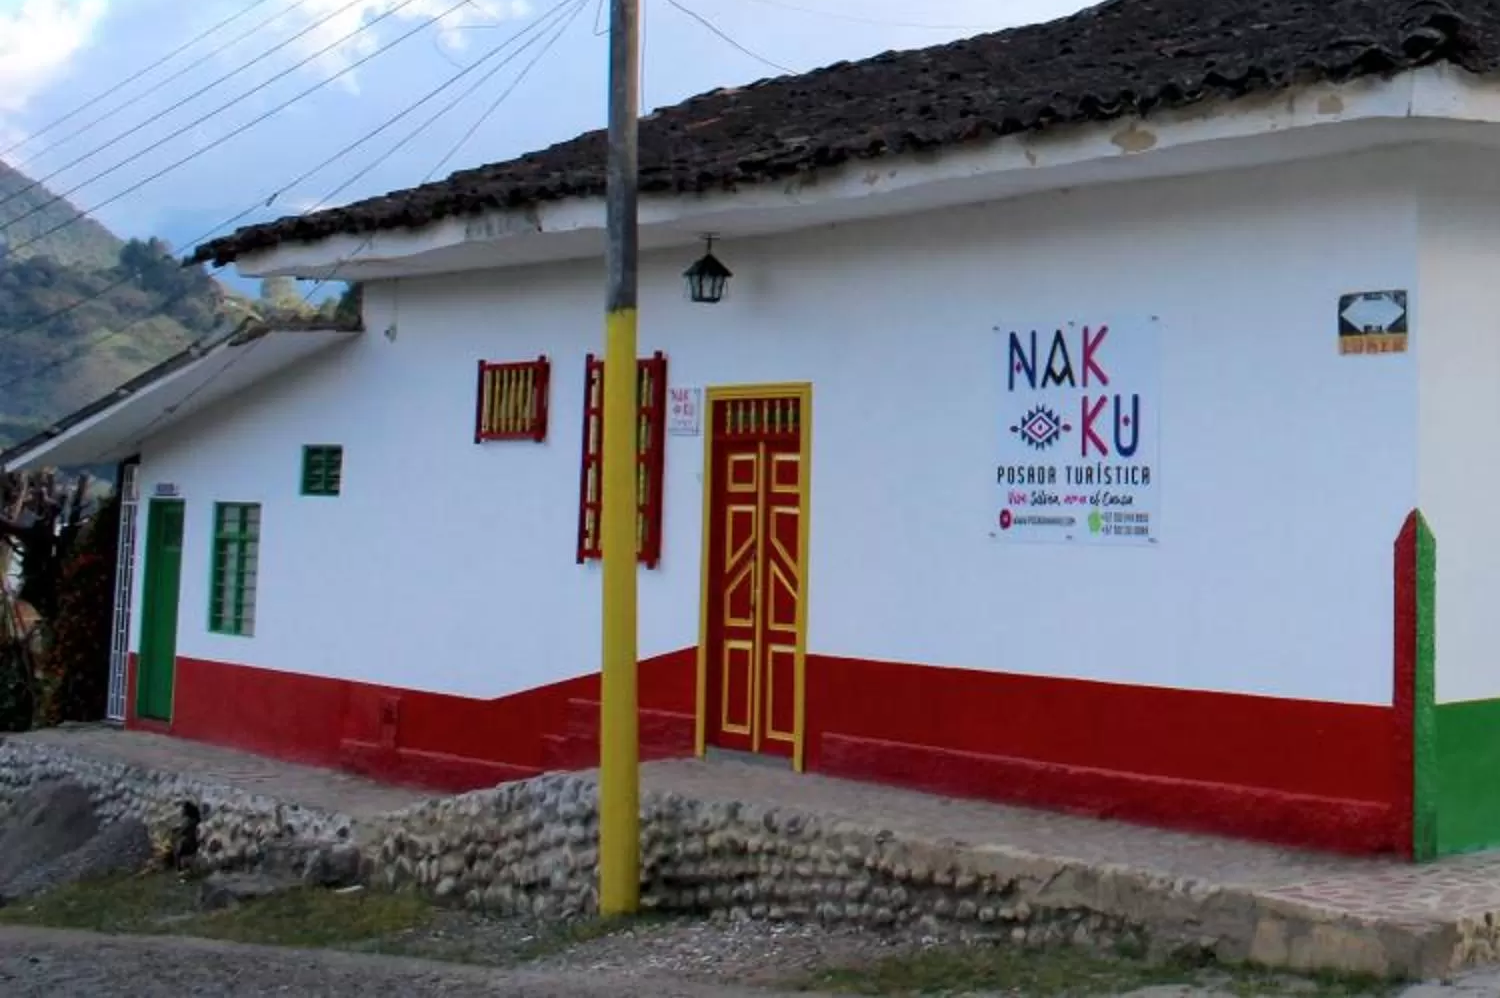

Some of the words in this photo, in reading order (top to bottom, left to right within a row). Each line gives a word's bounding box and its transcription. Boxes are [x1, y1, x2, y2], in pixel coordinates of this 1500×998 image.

[1008, 325, 1109, 391] NAK
[1081, 393, 1139, 457] KU
[997, 465, 1057, 485] POSADA
[1065, 462, 1151, 485] TURÍSTICA
